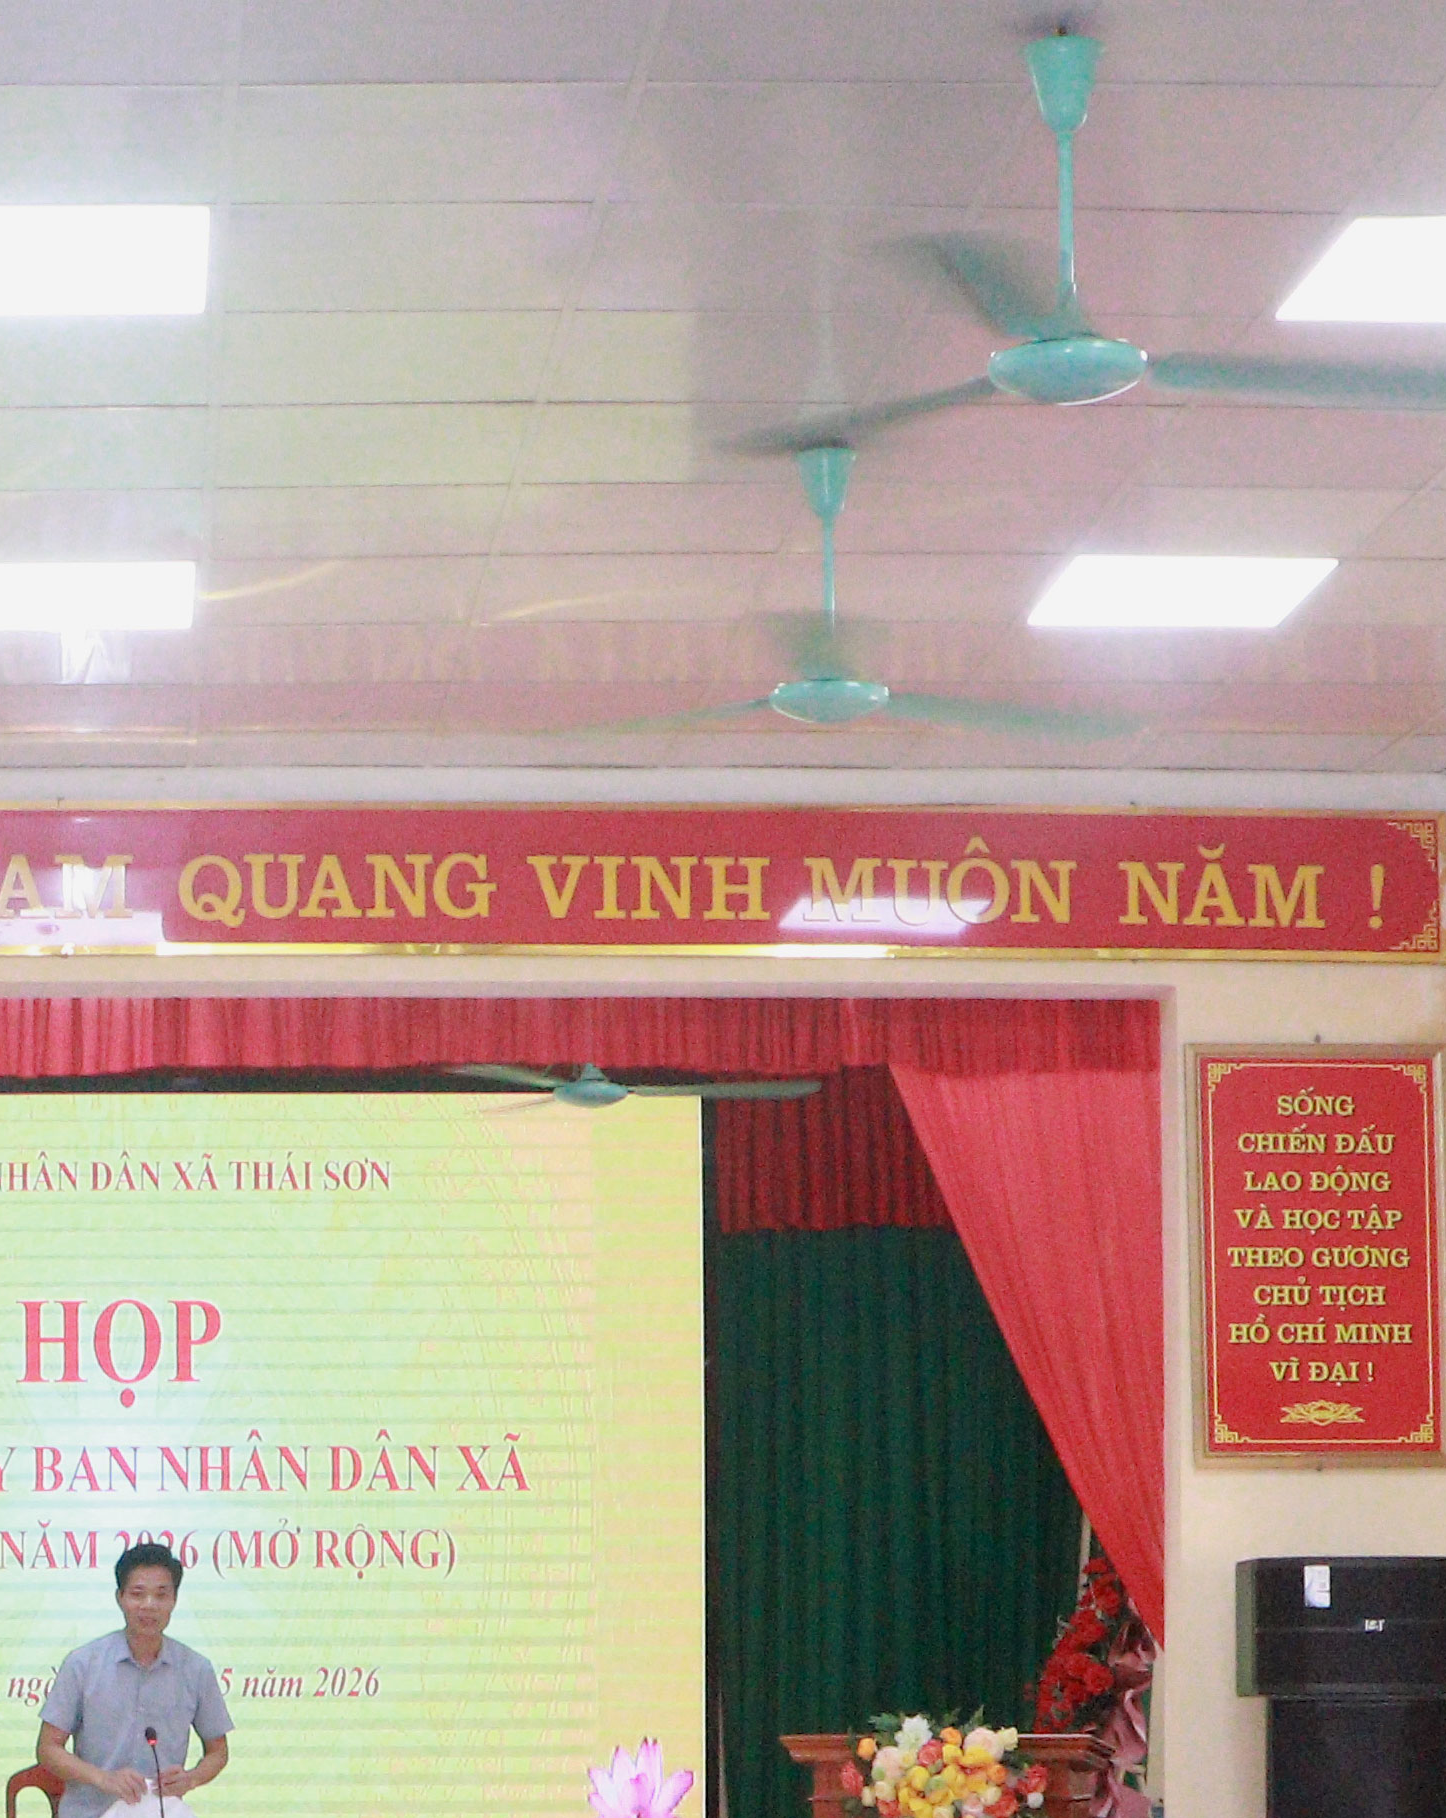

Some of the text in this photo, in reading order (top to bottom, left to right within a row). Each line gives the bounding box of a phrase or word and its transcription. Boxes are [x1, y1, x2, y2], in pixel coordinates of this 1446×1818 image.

[178, 853, 497, 928] QUANG
[527, 856, 770, 921] VINH
[803, 836, 1077, 925] MUÔN
[1118, 843, 1325, 928] NĂM
[1369, 864, 1385, 929] !
[1277, 1087, 1355, 1116] SỐNG
[1238, 1123, 1395, 1154] CHIẾN ĐẤU
[91, 1150, 160, 1191] DÂN
[172, 1153, 218, 1191] XÃ
[229, 1151, 312, 1191] THÁI
[324, 1157, 391, 1191] SƠN
[1244, 1165, 1391, 1196] LAO ĐỘNG
[1234, 1203, 1403, 1235] VÀ HỌC TẬP
[1228, 1245, 1410, 1268] THEO GƯƠNG
[1253, 1277, 1386, 1312] CHỦ TỊCH
[1228, 1313, 1412, 1344] HỒ CHÍ MINH
[15, 1298, 223, 1409] HỌP
[1308, 1361, 1360, 1386] ĐẠI
[1367, 1361, 1374, 1382] !
[32, 1446, 140, 1492] BAN
[157, 1429, 311, 1491] NHÂN
[328, 1429, 439, 1491] DÂN
[456, 1432, 530, 1491] XÃ
[212, 1518, 302, 1578] (MỞ
[315, 1525, 456, 1579] RỘNG)
[8, 1666, 57, 1707] ngà
[220, 1667, 233, 1697] 5
[242, 1667, 302, 1698] năm
[313, 1666, 380, 1697] 2026
